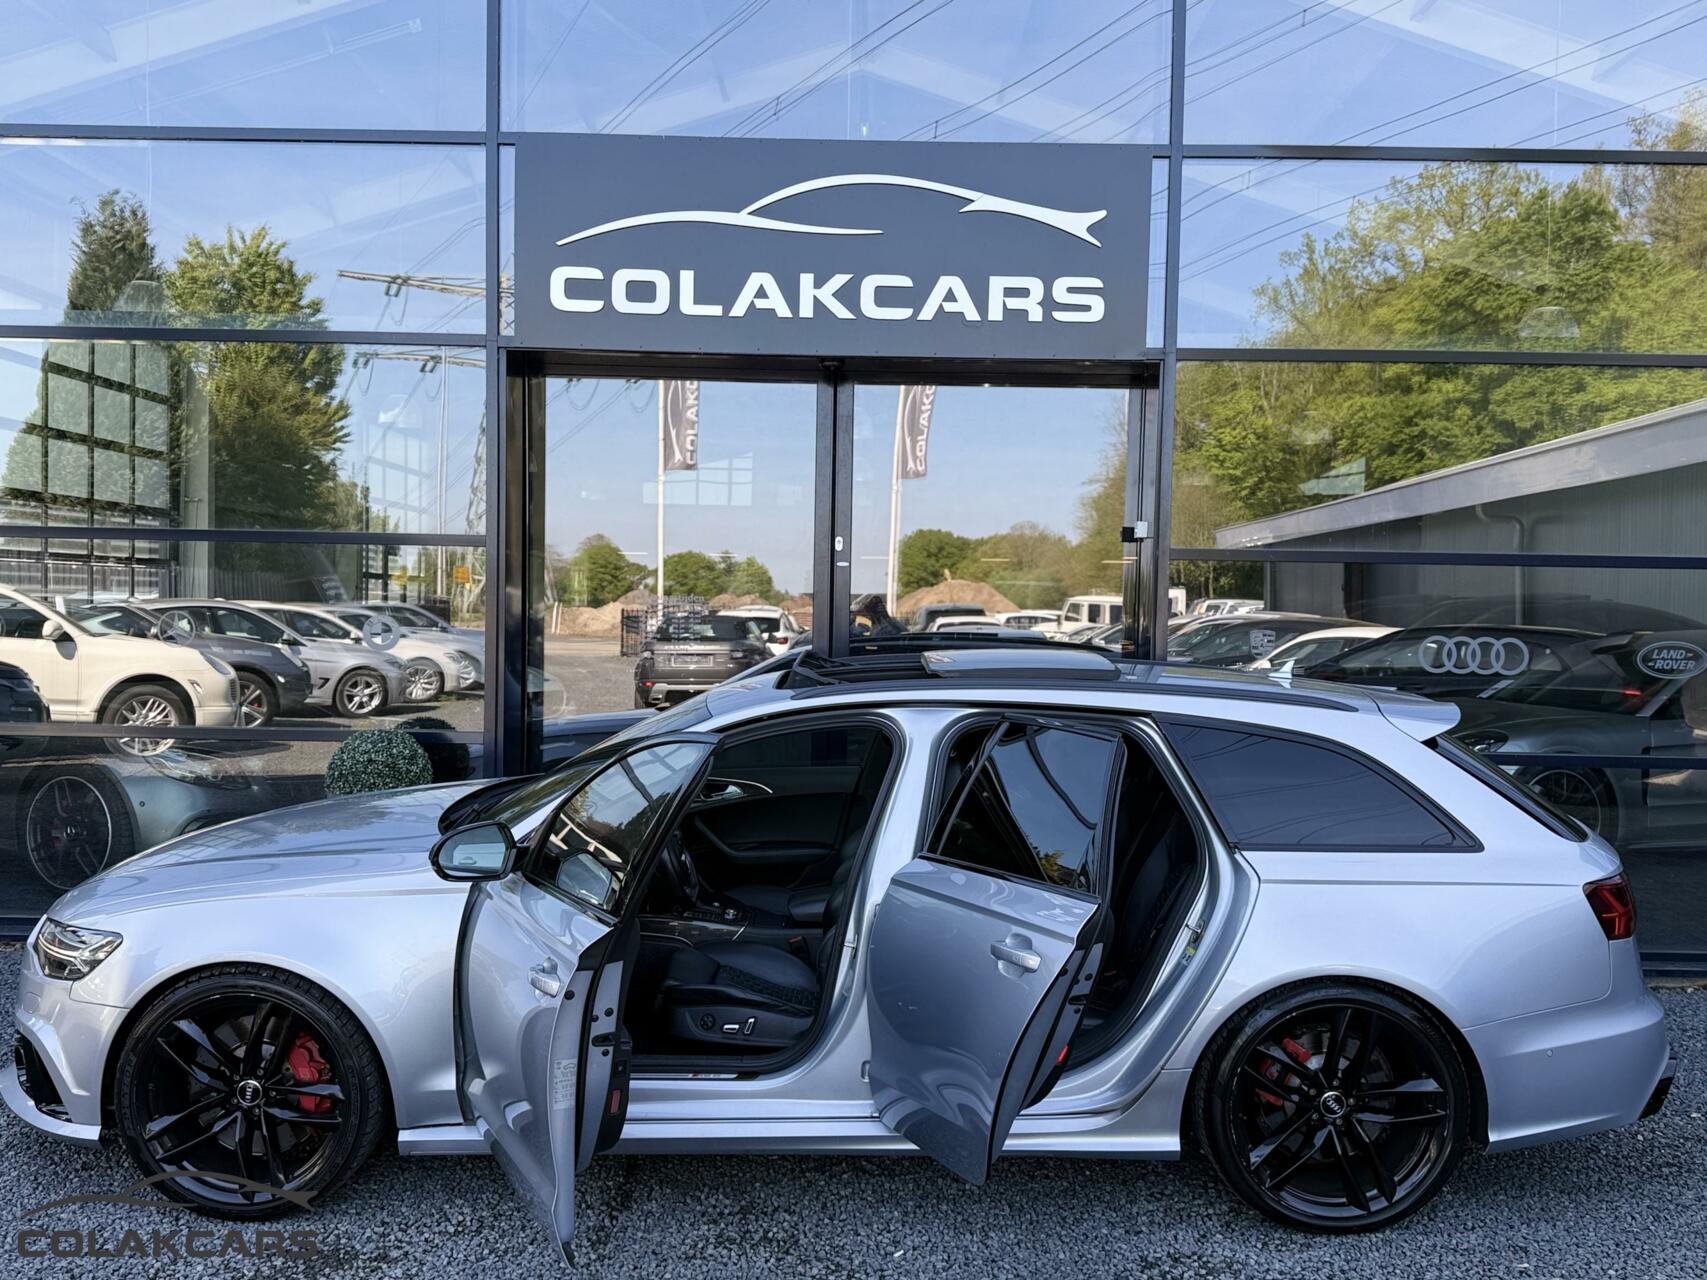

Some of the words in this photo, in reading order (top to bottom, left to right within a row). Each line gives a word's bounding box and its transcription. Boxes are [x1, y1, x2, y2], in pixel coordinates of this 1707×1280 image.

[549, 266, 1106, 323] COLAKCARS
[1652, 649, 1686, 659] LAND
[1655, 660, 1696, 670] ROVER
